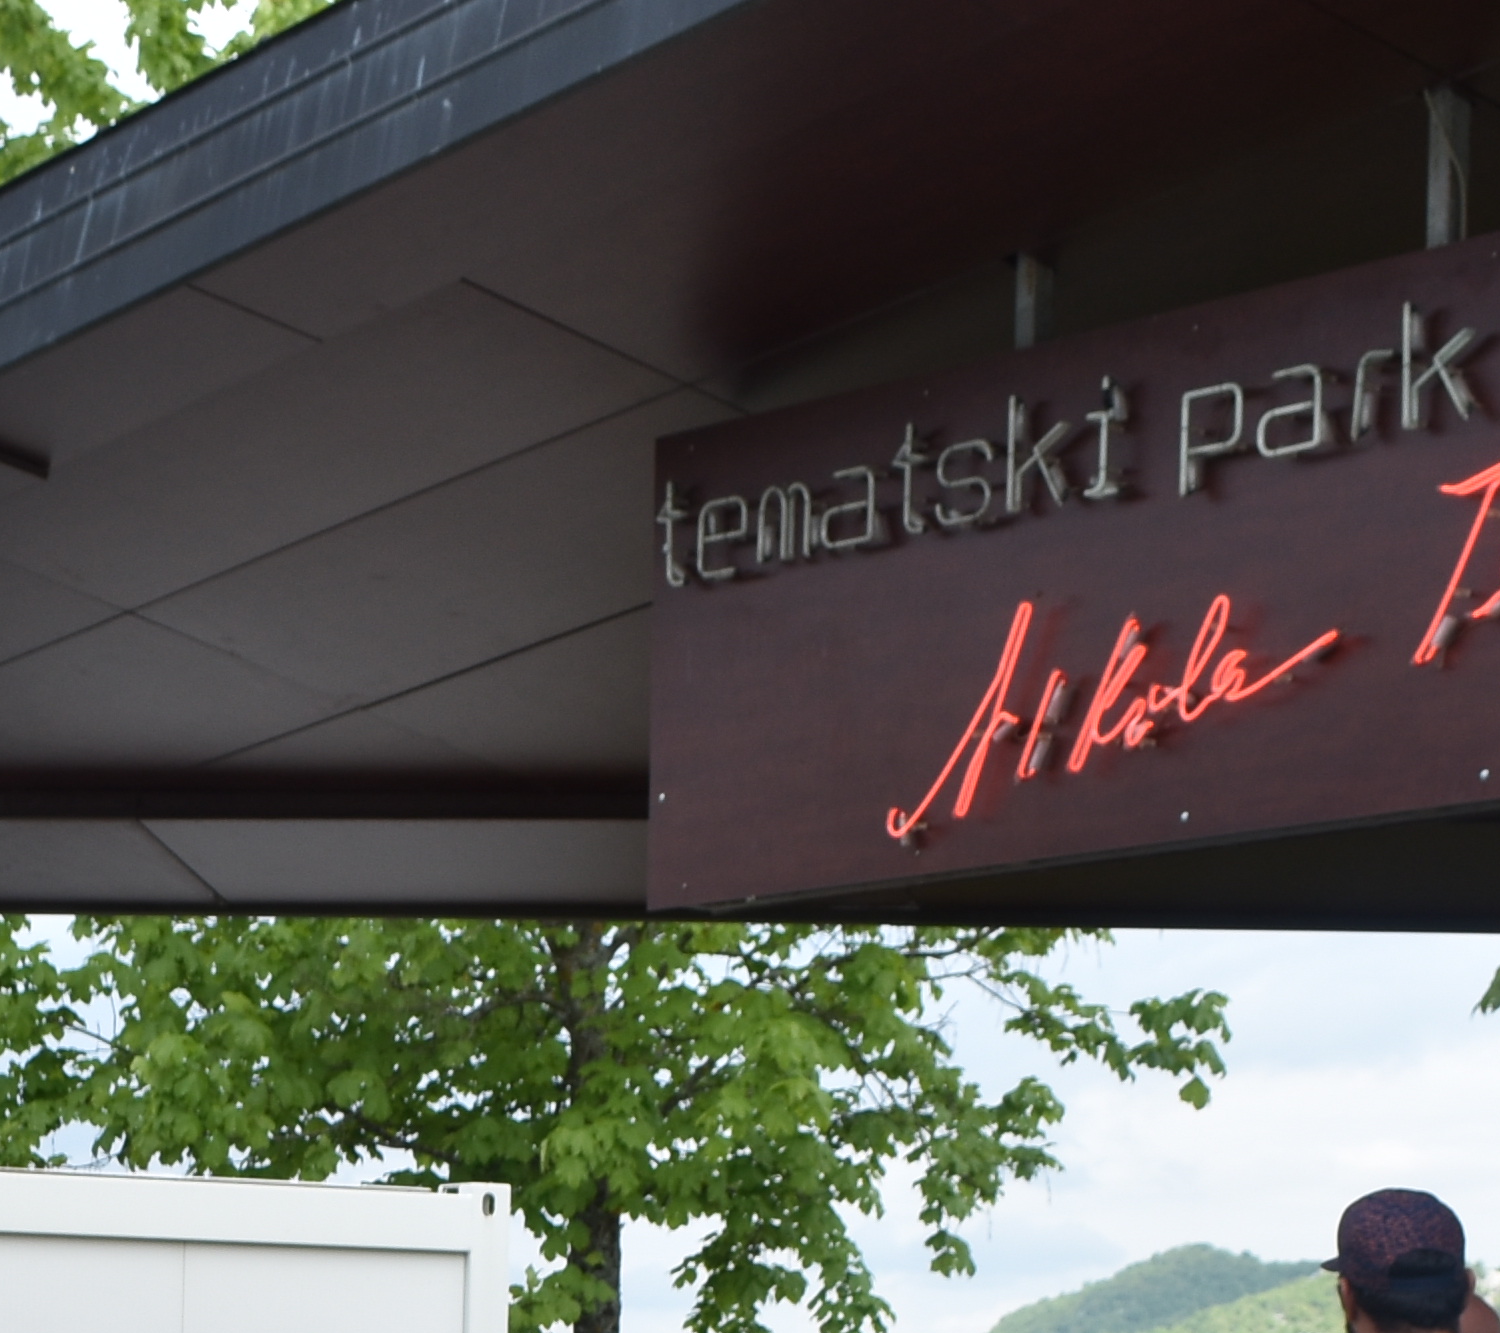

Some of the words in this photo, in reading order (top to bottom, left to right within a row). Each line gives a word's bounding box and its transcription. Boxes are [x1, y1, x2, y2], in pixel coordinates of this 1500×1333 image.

[657, 376, 1128, 587] tematski
[1177, 299, 1482, 498] park
[887, 594, 1339, 838] Nikola
